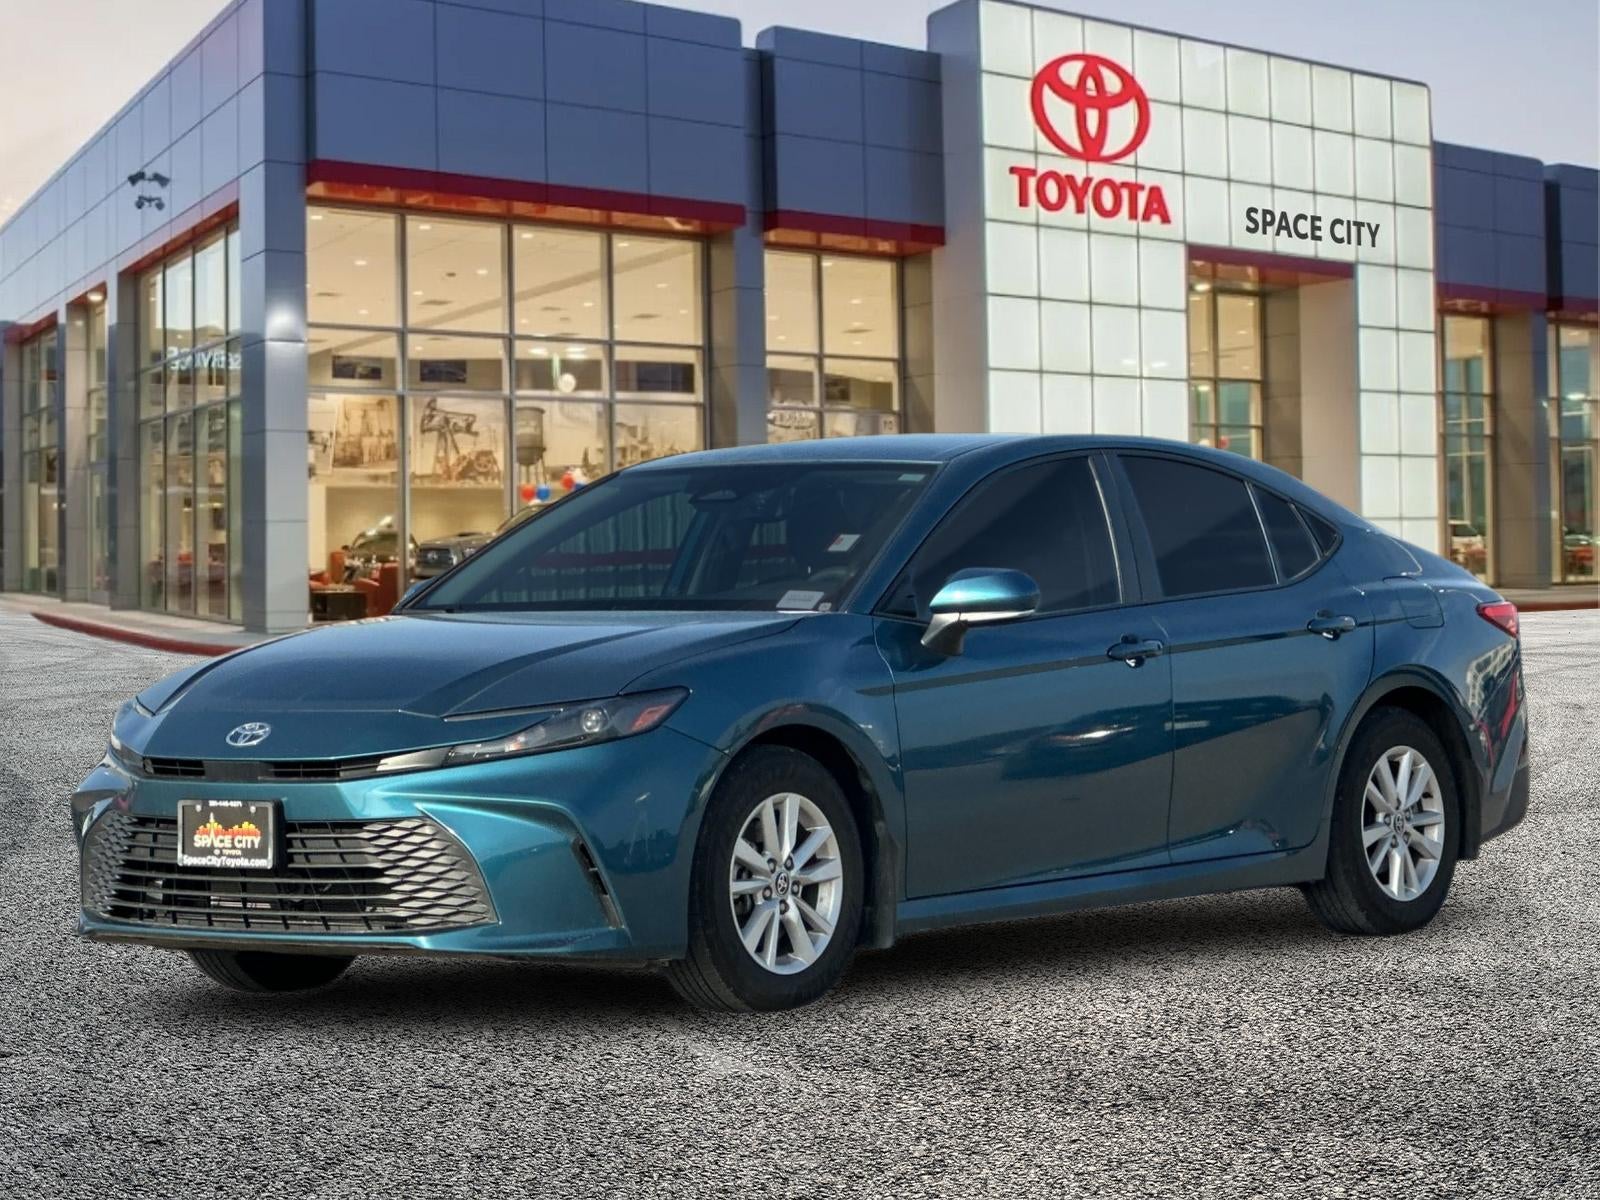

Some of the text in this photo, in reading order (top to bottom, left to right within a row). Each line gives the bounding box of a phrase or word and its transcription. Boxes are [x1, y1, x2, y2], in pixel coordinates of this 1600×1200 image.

[1009, 166, 1172, 225] TOYOTA
[1245, 206, 1381, 248] SPACE CITY
[194, 835, 261, 849] SPACE CITY
[183, 855, 267, 867] SpaceCityToyota.com
